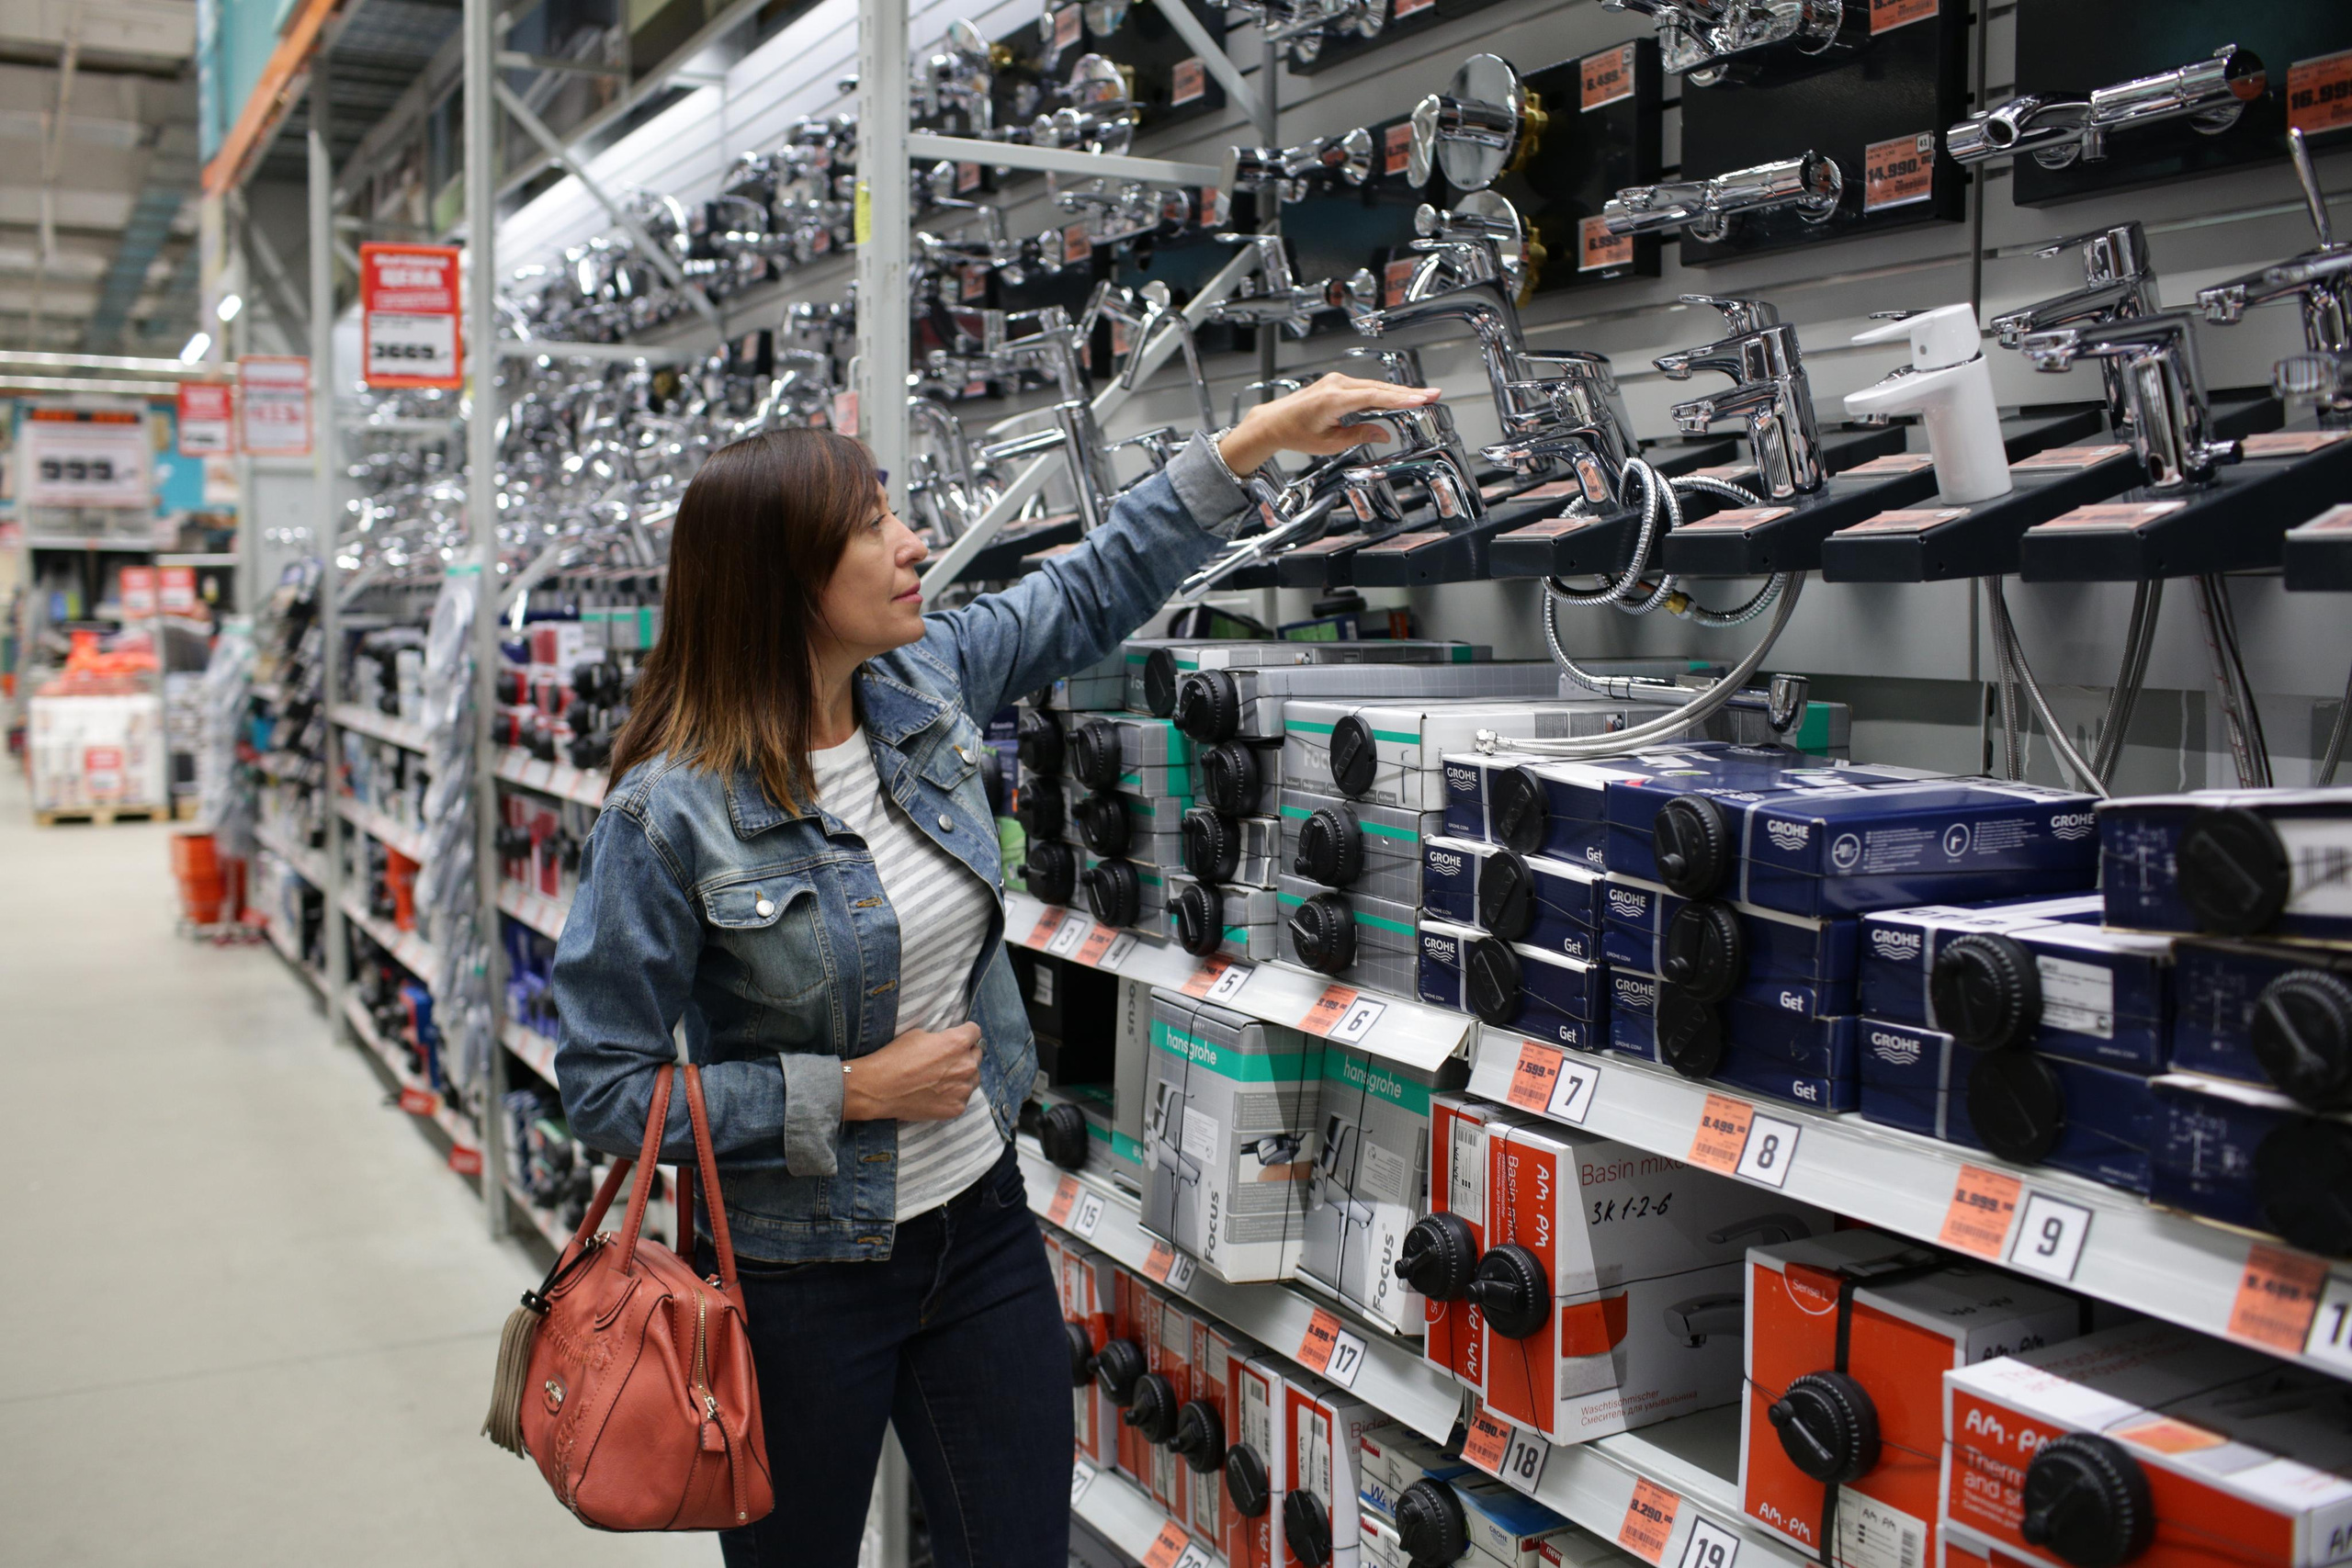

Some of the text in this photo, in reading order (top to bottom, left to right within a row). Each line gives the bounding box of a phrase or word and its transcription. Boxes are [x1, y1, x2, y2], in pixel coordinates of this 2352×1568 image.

[1447, 767, 1477, 782] GROHE
[1767, 819, 1810, 840] GROHE
[2051, 813, 2095, 829] GROHE
[1430, 851, 1462, 867] GROHE
[1586, 846, 1603, 864] Get
[1609, 888, 1646, 908] GROHE
[1424, 936, 1455, 953] GROHE
[1564, 938, 1582, 956] Get
[1871, 929, 1922, 948] GROHE
[1218, 973, 1239, 994] 5
[1615, 978, 1655, 997] GROHE
[1780, 990, 1804, 1012] Get
[1347, 1010, 1370, 1031] 6
[1559, 1025, 1577, 1043] Get
[1871, 1031, 1921, 1055] GROHE
[1166, 1025, 1217, 1066] hansgrohe
[1343, 1055, 1402, 1099] hansgrohe
[1564, 1075, 1584, 1107] 7
[1792, 1079, 1817, 1101] Get
[1757, 1134, 1780, 1169] 8
[1581, 1158, 1634, 1187] Basin
[1081, 1203, 1099, 1229] 15
[1507, 1207, 1519, 1245] mixe
[2036, 1216, 2064, 1257] 9
[1173, 1255, 1193, 1282] 16
[1792, 1278, 1821, 1299] Sense
[1335, 1344, 1358, 1372] 17
[1580, 1390, 1660, 1416] Waschtischmischer
[1580, 1409, 1626, 1427] Смеситель
[1627, 1404, 1644, 1416] для
[1512, 1441, 1539, 1478] 18
[1488, 1524, 1509, 1544] GROHE
[1545, 1546, 1563, 1561] new
[1693, 1538, 1725, 1568] 19
